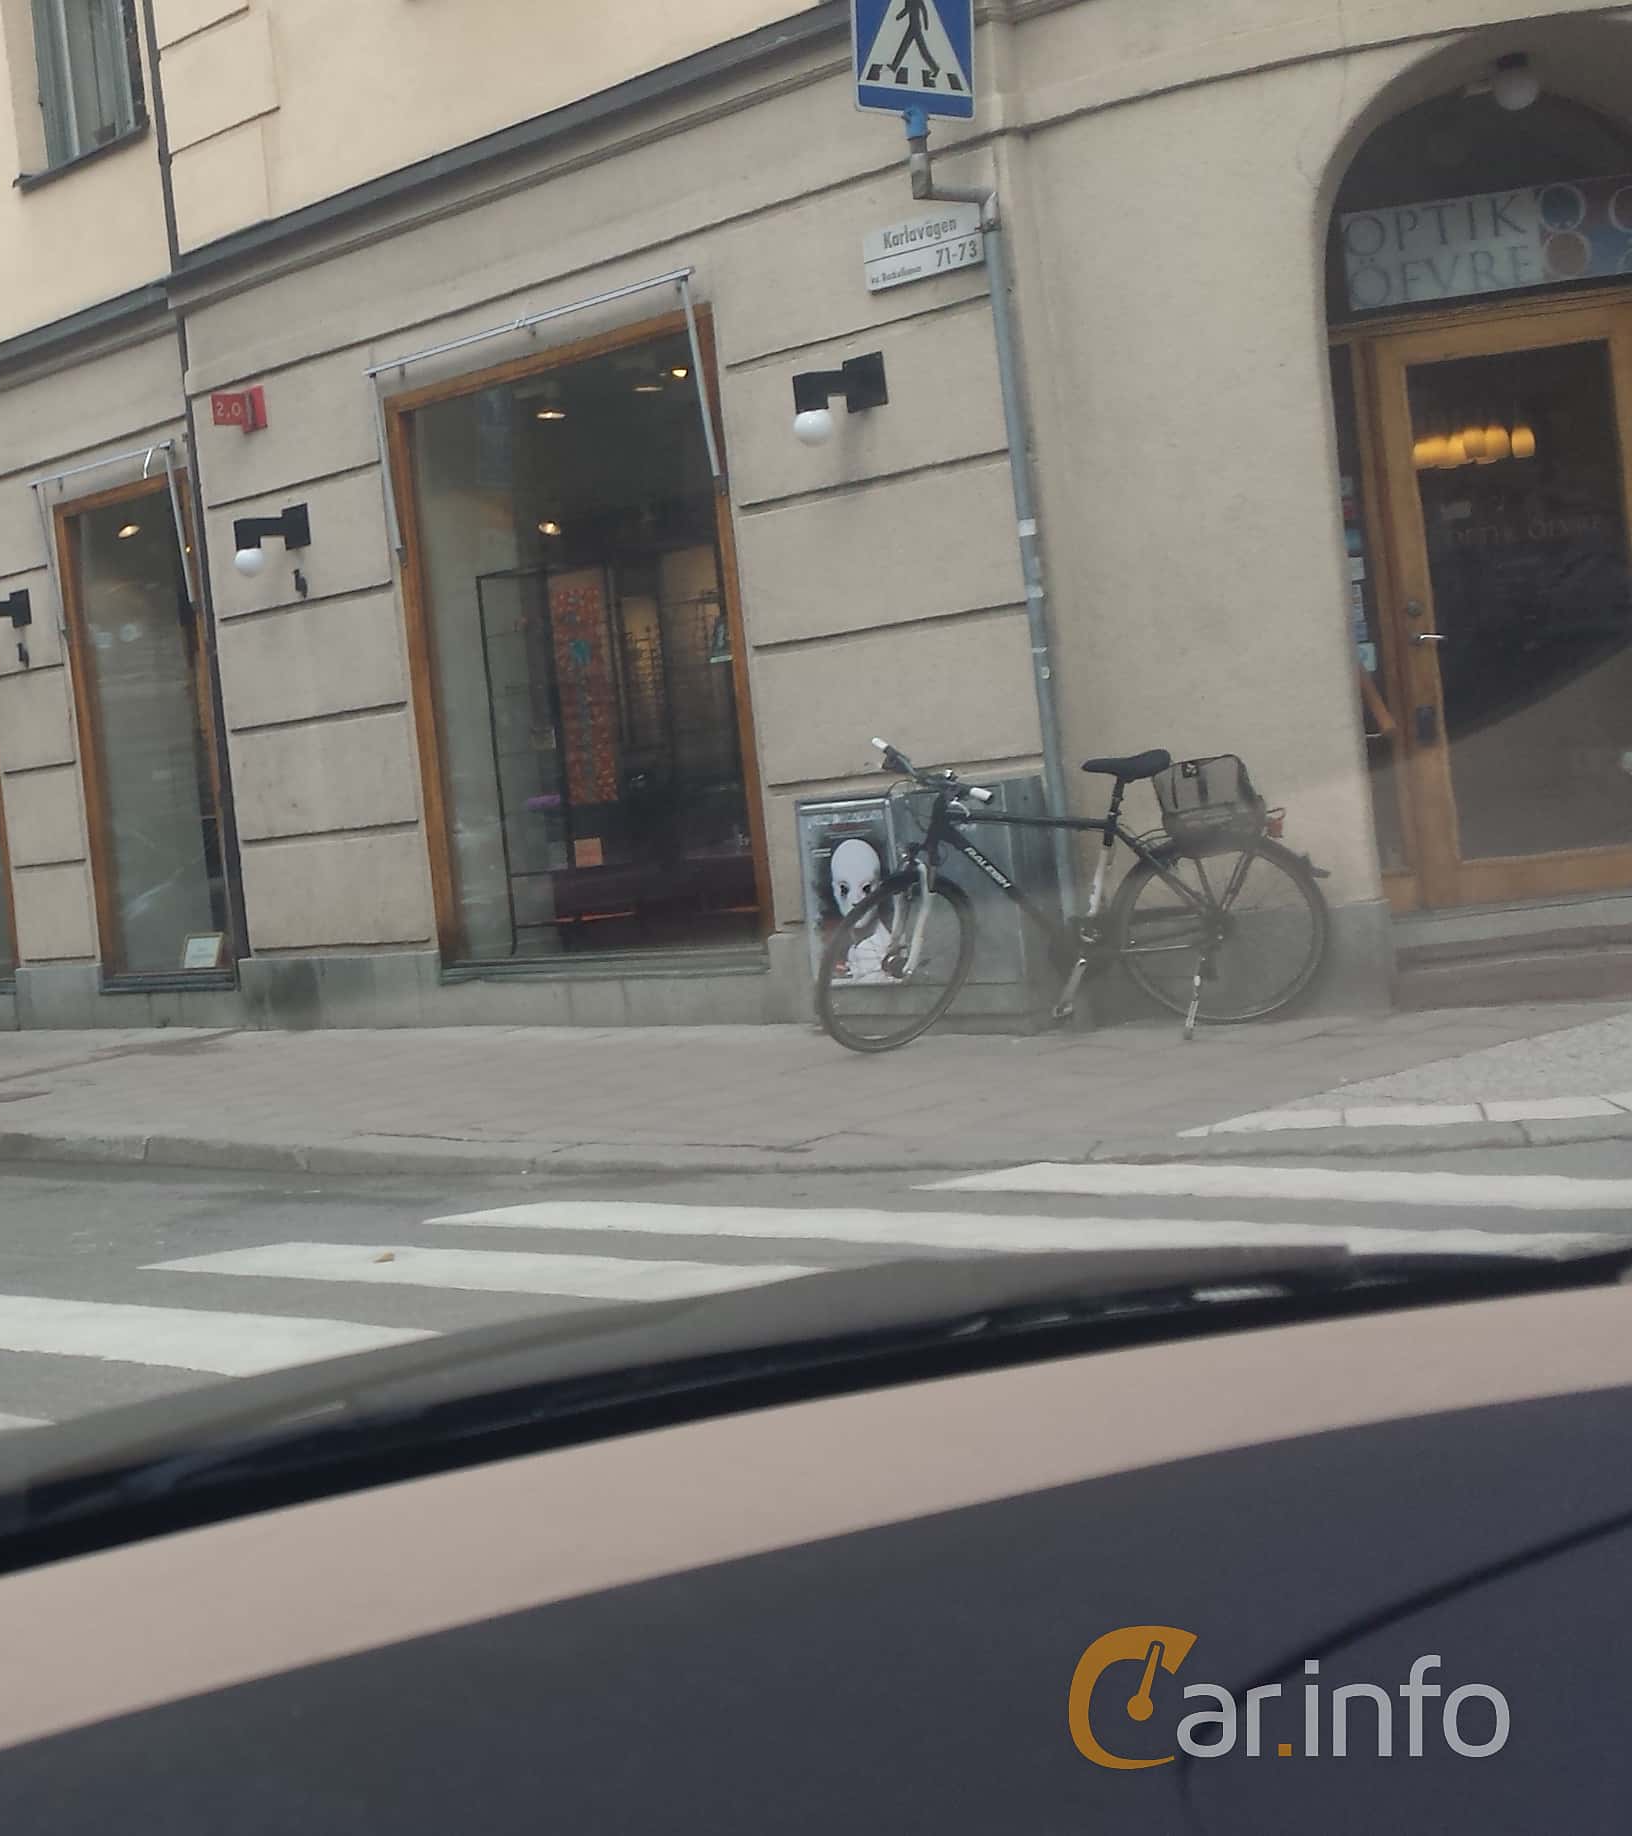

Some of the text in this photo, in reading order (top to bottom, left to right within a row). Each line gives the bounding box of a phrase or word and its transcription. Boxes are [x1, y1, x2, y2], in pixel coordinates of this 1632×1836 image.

[935, 239, 978, 268] 71-73
[1343, 194, 1527, 256] OPTIK
[1349, 245, 1531, 303] ÖFVRE
